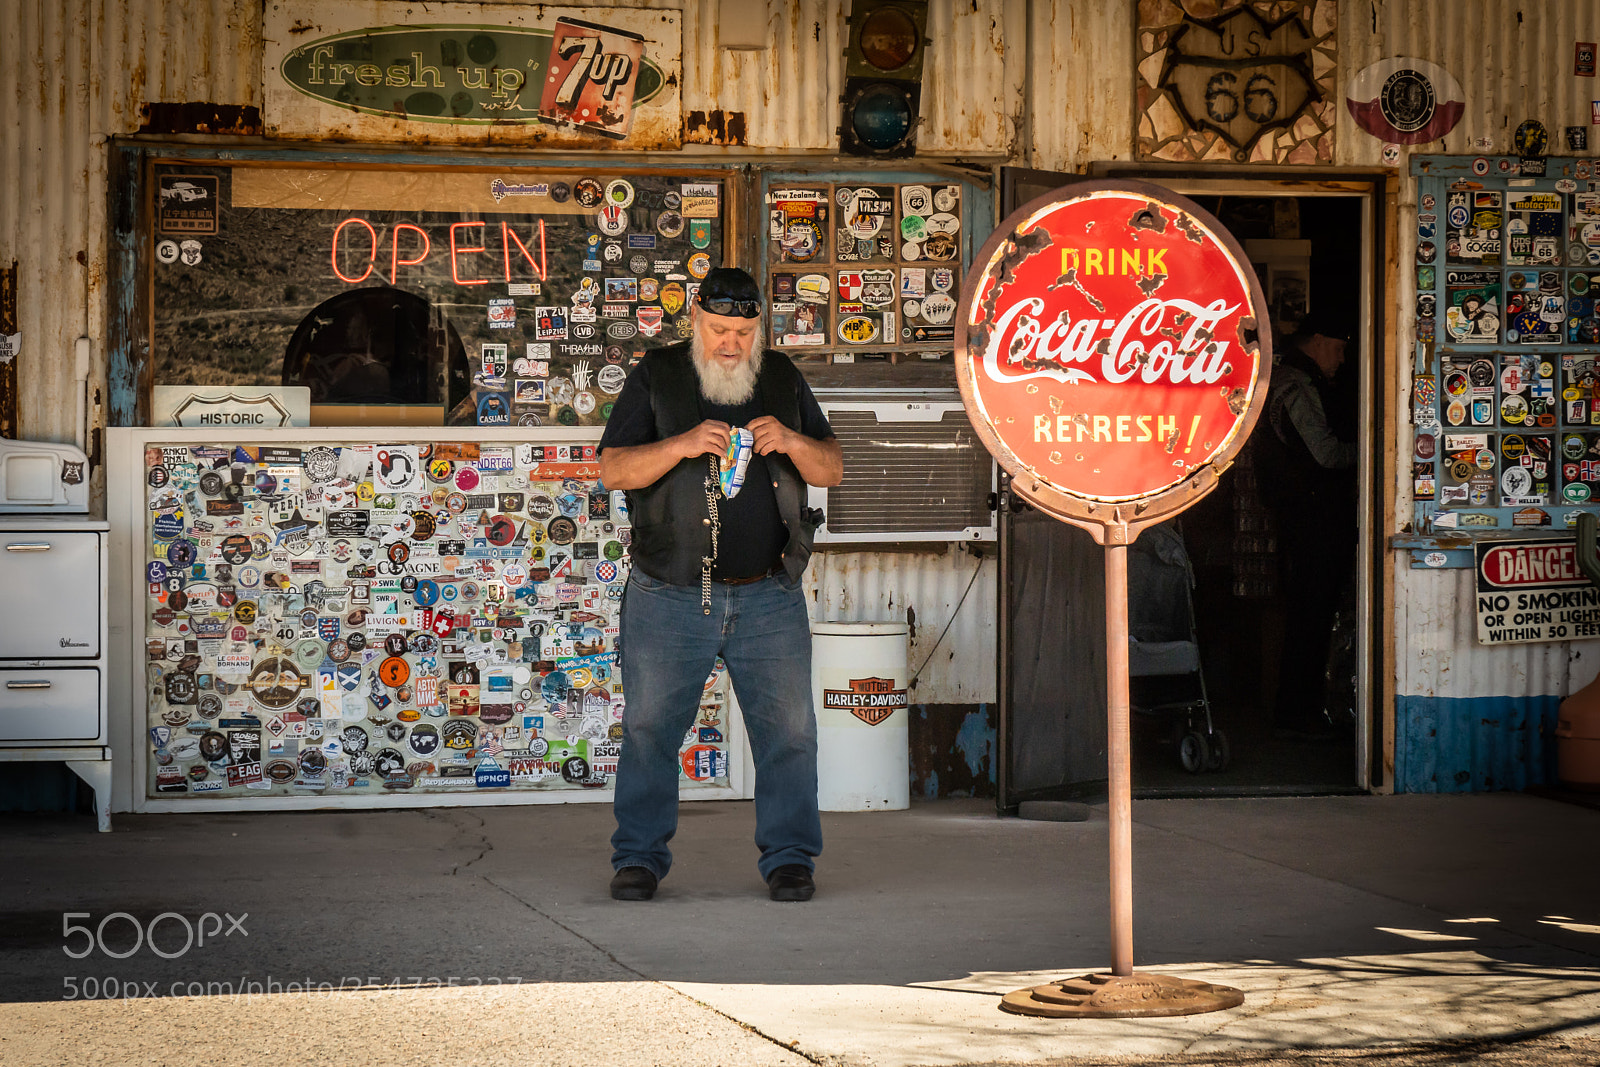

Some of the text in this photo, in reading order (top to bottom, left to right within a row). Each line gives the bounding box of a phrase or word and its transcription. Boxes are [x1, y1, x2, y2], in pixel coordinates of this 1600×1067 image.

[1206, 71, 1278, 123] 66
[477, 94, 540, 113] with
[773, 189, 817, 200] New Zealand
[911, 198, 924, 207] 66
[331, 218, 547, 285] OPEN
[1466, 242, 1501, 254] GOGGLE
[1538, 248, 1553, 257] 66
[1060, 248, 1169, 276] DRINK
[541, 317, 564, 329] RB
[576, 325, 591, 335] LVB
[983, 297, 1242, 385] Coca-Cola
[200, 413, 264, 424] HISTORIC
[479, 414, 509, 424] CASUALS
[201, 538, 212, 547] 66
[167, 571, 184, 580] ASA
[169, 579, 182, 592] 8
[1479, 595, 1510, 613] NO
[455, 614, 471, 628] 58
[473, 619, 487, 627] HSV
[1484, 615, 1506, 628] OR
[1513, 611, 1552, 626] OPEN
[234, 628, 246, 638] FD
[276, 628, 294, 640] 40
[1488, 627, 1541, 642] WITHIN
[1548, 624, 1568, 638] 50
[544, 646, 573, 658] EIRE
[417, 679, 437, 692] АВТО
[858, 680, 889, 693] MOTOR
[858, 709, 889, 722] CYCLES
[239, 764, 261, 777] EAG
[477, 774, 509, 783] #PNCF
